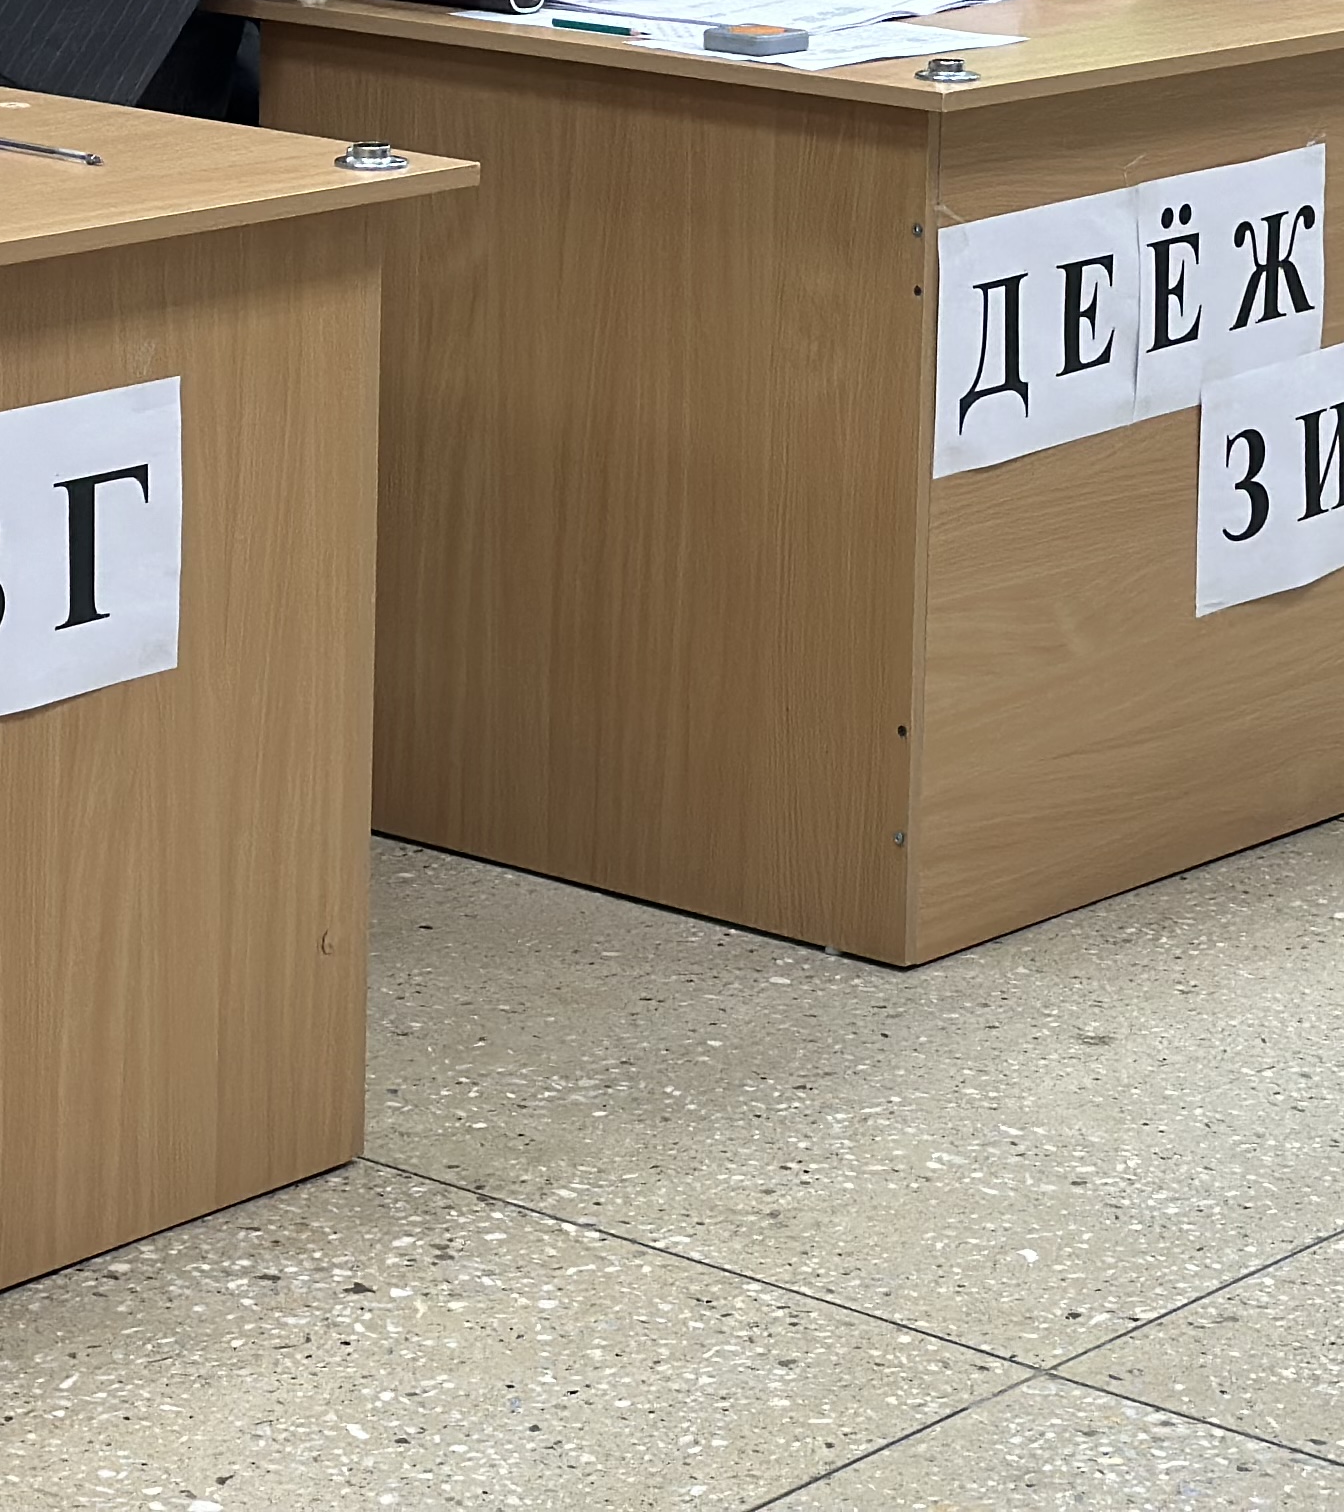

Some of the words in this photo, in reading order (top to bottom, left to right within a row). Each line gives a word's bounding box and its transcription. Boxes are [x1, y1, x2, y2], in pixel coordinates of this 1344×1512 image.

[959, 272, 1029, 436] Д
[1056, 253, 1115, 377] Е
[1146, 203, 1202, 354] Ё
[1229, 204, 1316, 332] Ж
[53, 463, 149, 631] Г
[1223, 428, 1270, 542] З
